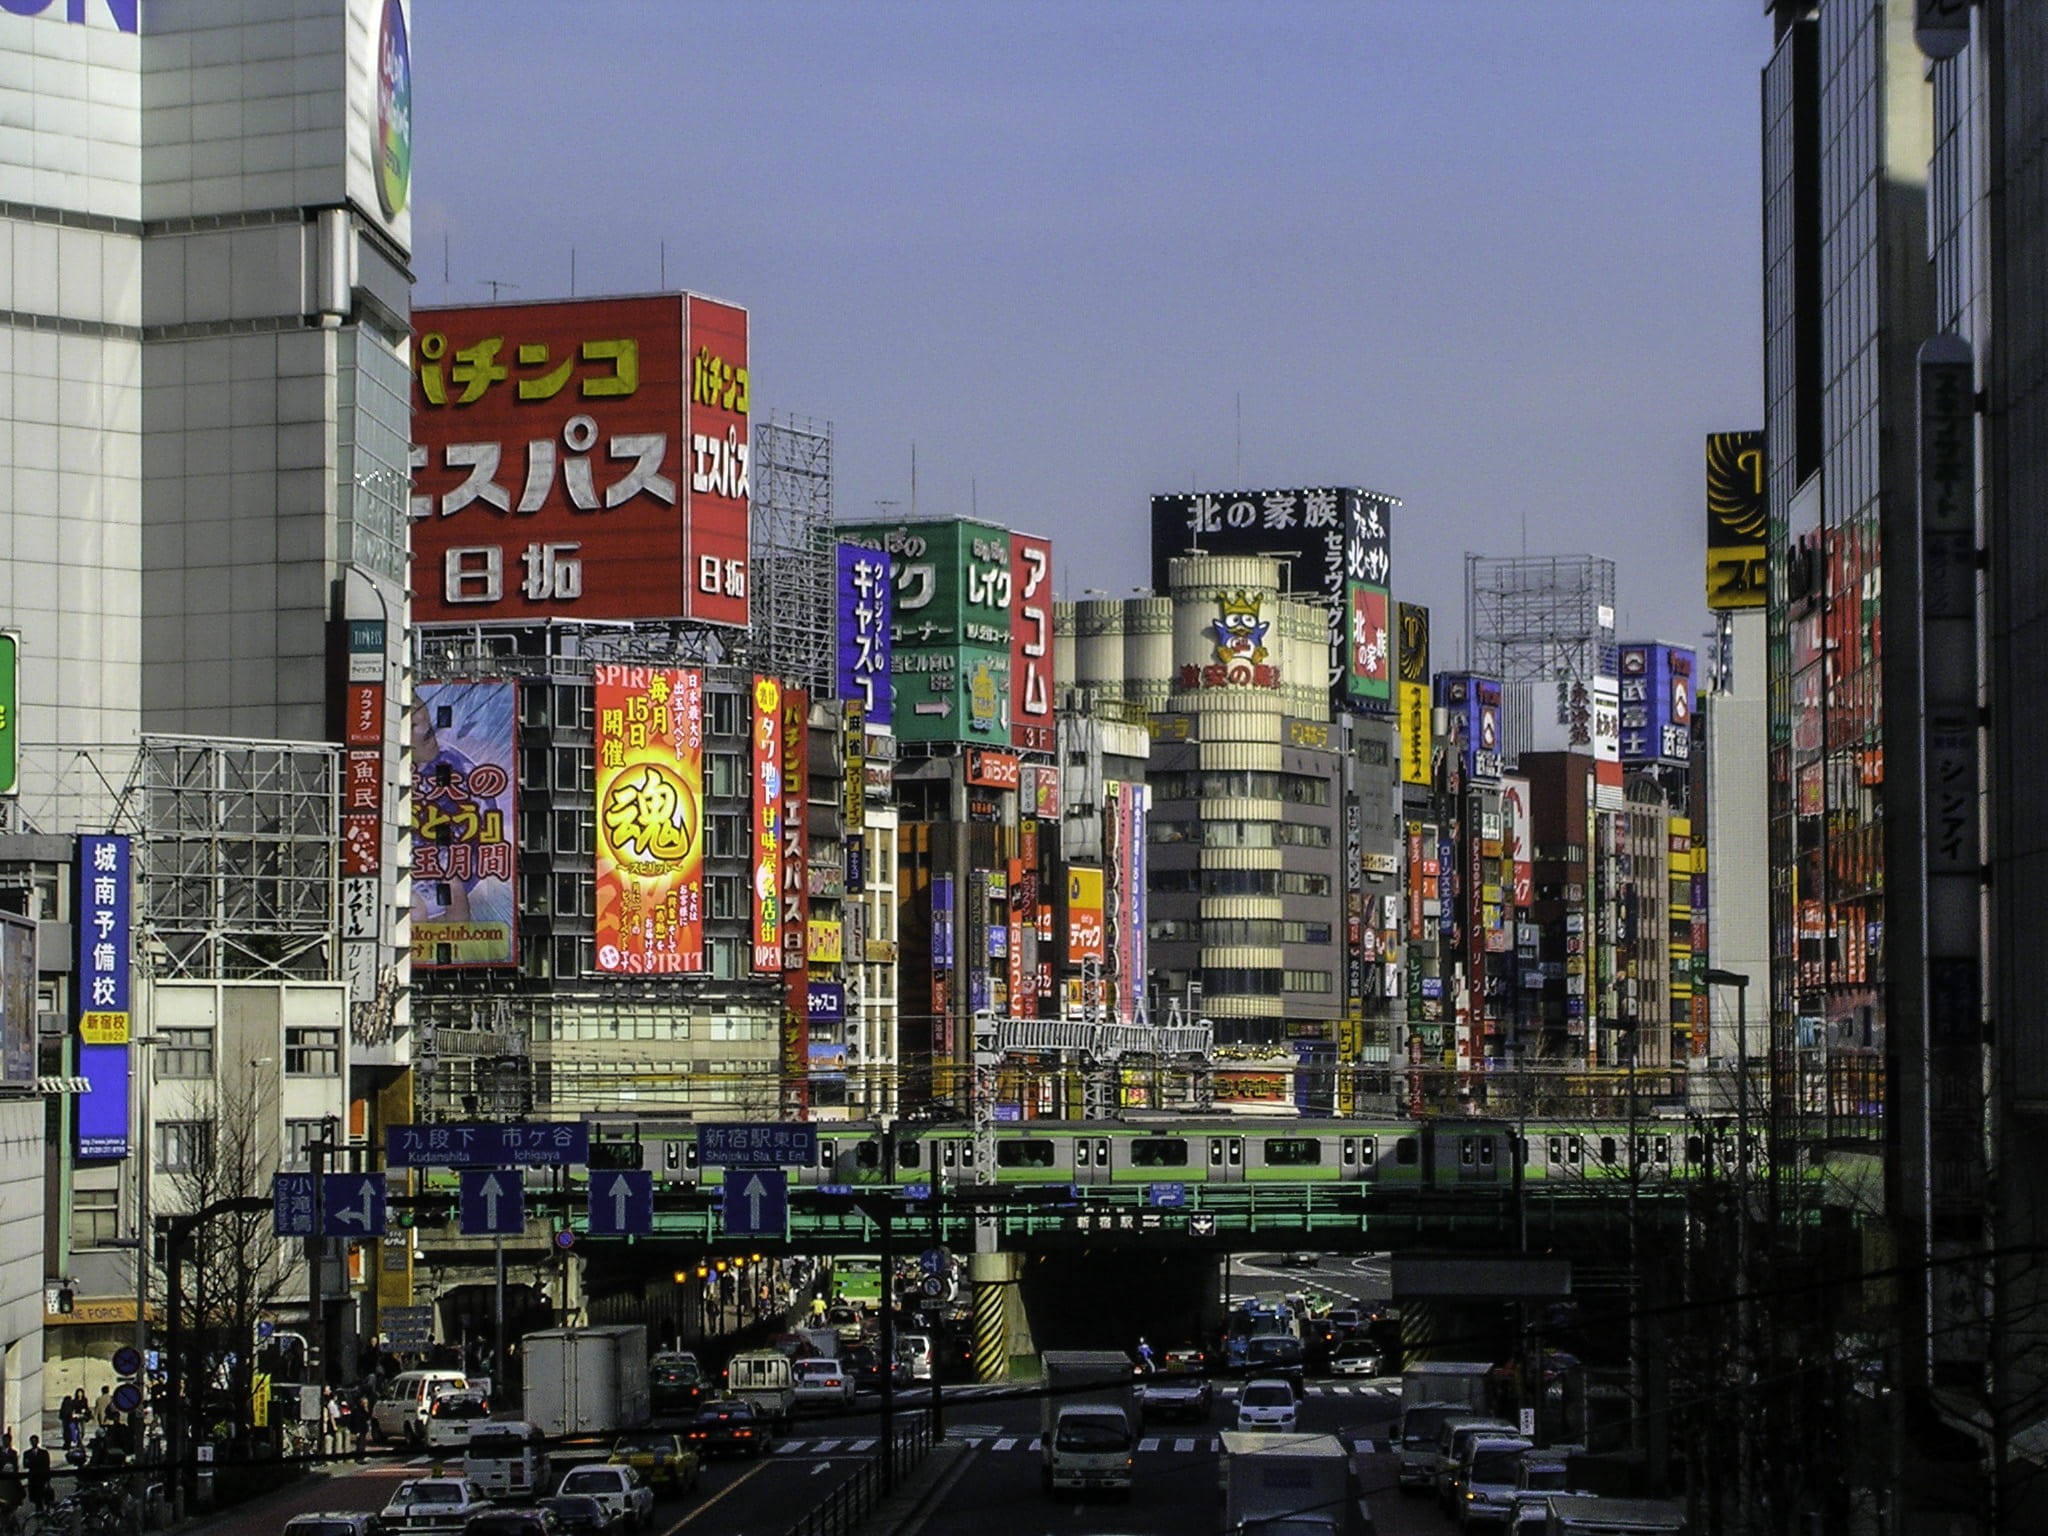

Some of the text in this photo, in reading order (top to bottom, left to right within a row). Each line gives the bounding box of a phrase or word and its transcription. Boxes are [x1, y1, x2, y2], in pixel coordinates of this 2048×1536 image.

[694, 345, 749, 414] パチンコ
[692, 423, 750, 499] エスパス
[1187, 494, 1338, 533] 北の家族
[445, 541, 584, 603] 日拓
[700, 553, 745, 599] 日拓
[889, 562, 936, 609] ク
[969, 563, 1011, 609] レイク
[854, 558, 875, 713] キャスコ
[874, 562, 885, 671] クレジットの
[1023, 546, 1047, 716] アコム
[360, 688, 373, 731] カラオケ
[625, 696, 649, 750] 15日
[648, 672, 671, 735] 毎月
[1622, 678, 1648, 755] 武富士
[601, 708, 626, 770] 開催
[784, 704, 800, 792] パチンコ
[849, 715, 861, 757] 麻雀
[352, 760, 378, 809] 魚民
[602, 766, 692, 860] 魂
[783, 800, 802, 923] エスパス
[92, 843, 117, 1006] 城南予備校
[1069, 922, 1102, 948] ディック
[755, 946, 781, 968] OPEN
[87, 1014, 125, 1030] 新宿校
[808, 993, 838, 1011] キャスコ
[402, 1128, 476, 1149] 九段下
[407, 1149, 561, 1163] Kudanshita Ichigaya
[704, 1127, 809, 1149] 新宿駅東口
[704, 1149, 750, 1162] Shinjuku
[290, 1176, 313, 1233] 小滝橋
[1076, 1214, 1134, 1230] 新宿駅
[87, 1306, 123, 1319] FORCE
